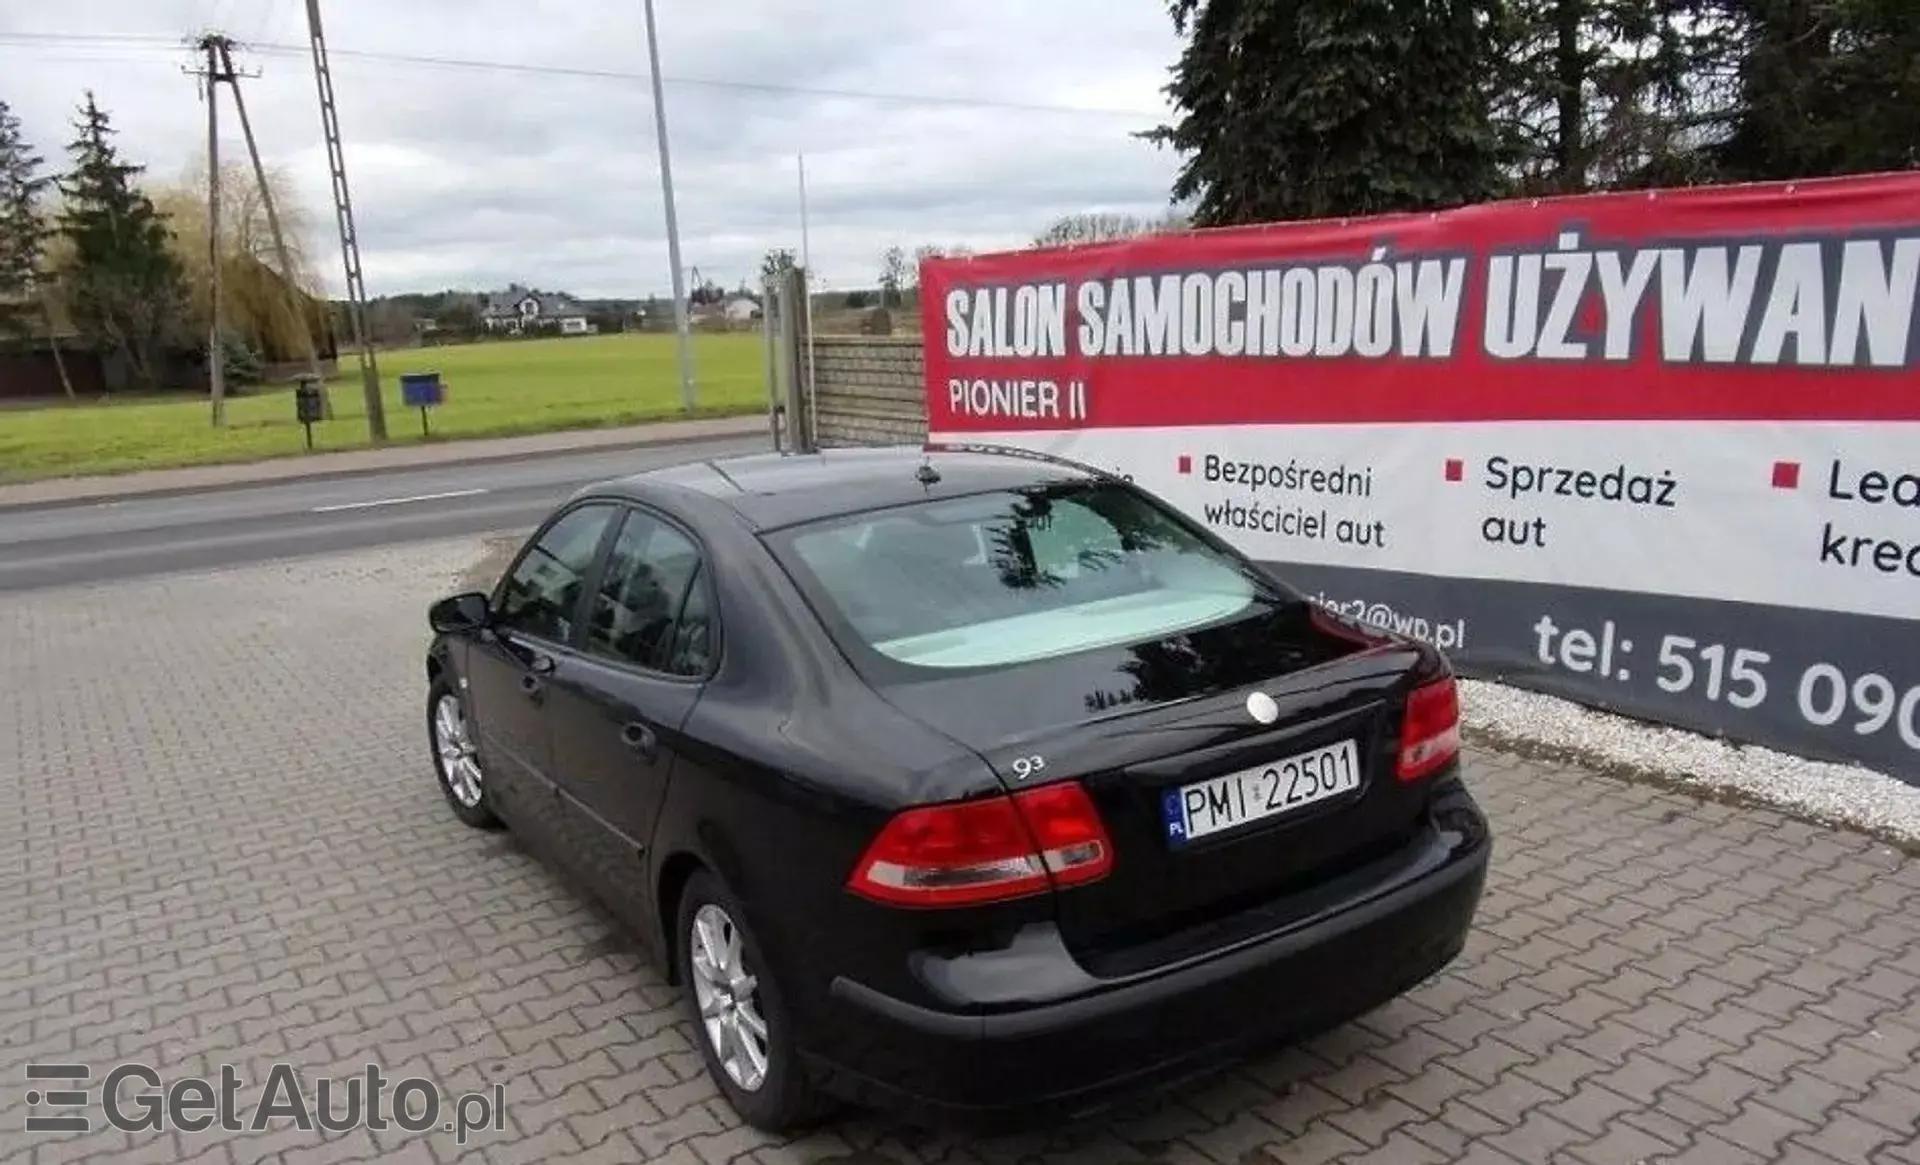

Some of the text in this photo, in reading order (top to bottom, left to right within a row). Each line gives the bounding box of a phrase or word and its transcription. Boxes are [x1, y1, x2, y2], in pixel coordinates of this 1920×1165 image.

[946, 231, 1920, 366] SALON SAMOCHODÓW UŻYWAN
[948, 378, 1087, 420] PIONIER II
[1204, 454, 1372, 497] Bezpośredni
[1484, 456, 1678, 507] Sprzedaż
[1204, 500, 1384, 548] właściciel aut
[1481, 516, 1547, 548] aut
[1533, 614, 1634, 682] tel:
[1656, 634, 1771, 708] 515
[1184, 745, 1356, 835] PMI 22501
